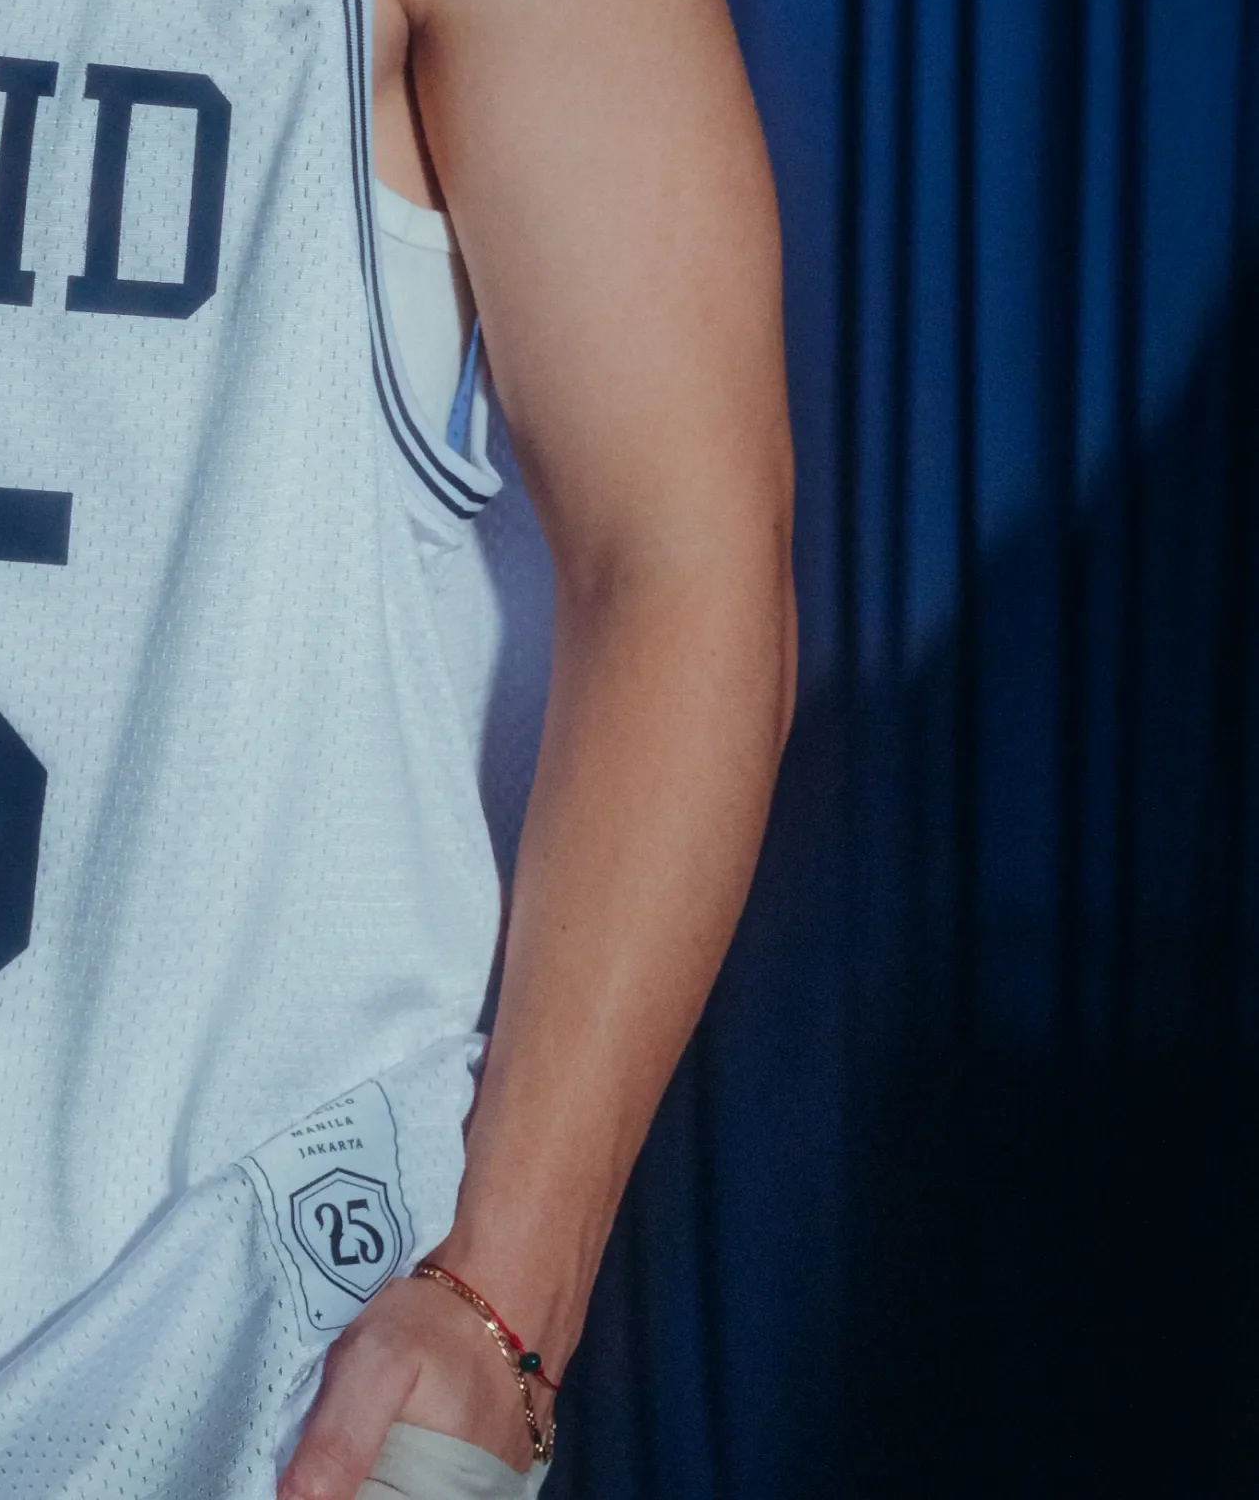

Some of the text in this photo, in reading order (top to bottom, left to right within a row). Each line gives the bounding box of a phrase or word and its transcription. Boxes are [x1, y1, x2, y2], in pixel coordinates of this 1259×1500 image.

[290, 1116, 353, 1137] MANILA
[298, 1138, 363, 1159] JAKARTA
[314, 1198, 384, 1266] 25
